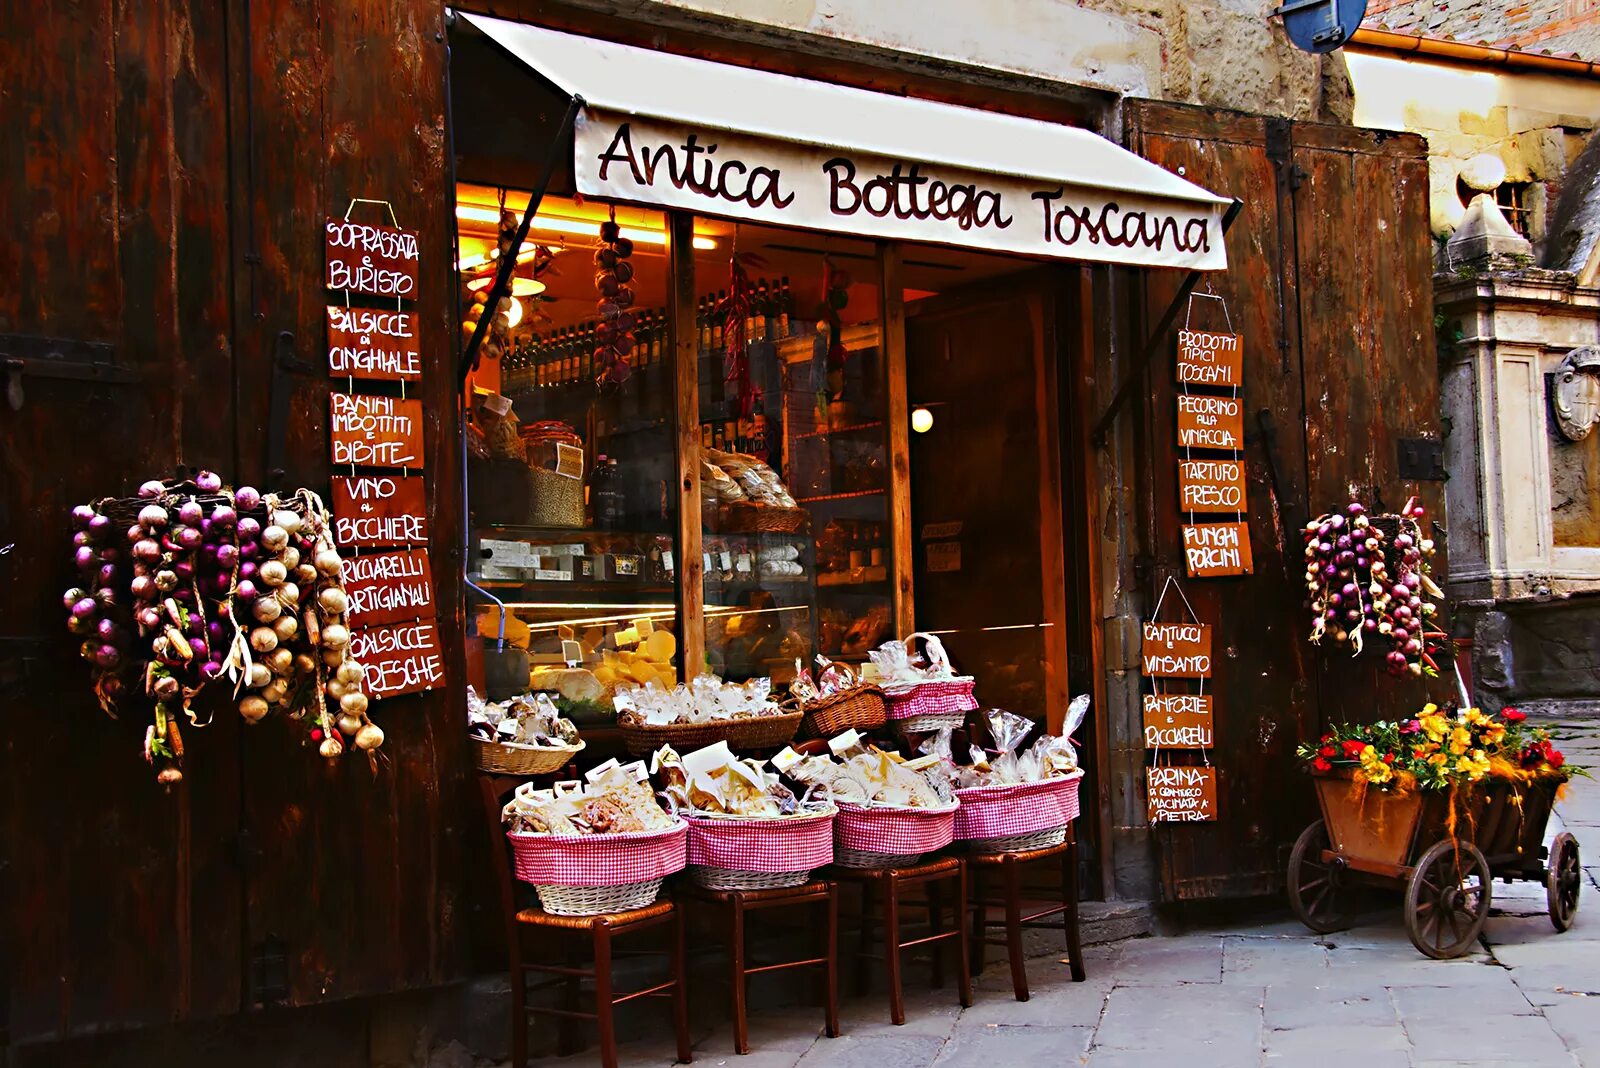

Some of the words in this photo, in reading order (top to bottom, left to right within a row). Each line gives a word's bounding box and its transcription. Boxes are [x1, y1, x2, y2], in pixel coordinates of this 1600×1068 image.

[598, 122, 795, 208] Antica
[823, 157, 1012, 231] Bottega
[1031, 186, 1211, 253] Toscana
[327, 223, 419, 261] SOPRASSATA
[329, 260, 413, 293] BURISTO
[330, 310, 412, 337] SALSICCE
[1178, 331, 1237, 351] PRODOTTI
[329, 347, 420, 374] CINGHIALE
[1182, 347, 1215, 362] TIPICI
[1177, 362, 1231, 383] TOSCANI
[333, 393, 393, 416] PANINI
[1178, 395, 1238, 416] PECORINO
[332, 412, 411, 436] IMBOTTITI
[1196, 414, 1217, 426] ALLA
[1180, 428, 1237, 447] VINACCIA
[334, 440, 415, 464] BIBITE
[1181, 462, 1239, 481] TARTUFO
[346, 477, 396, 499] VINO
[1184, 485, 1240, 506] FRESCO
[336, 514, 429, 543] BICCHIERE
[1187, 546, 1240, 572] PORCINI
[341, 556, 423, 584] RICCIARELLI
[350, 625, 433, 658] SALSICCE
[1144, 625, 1201, 643] CANTUCCI
[1144, 655, 1210, 673] VINSANTO
[1144, 694, 1208, 714] PANFORTE
[1148, 767, 1208, 787] FARINA
[1149, 798, 1199, 809] MACINATA
[1156, 809, 1210, 821] PIETRA
